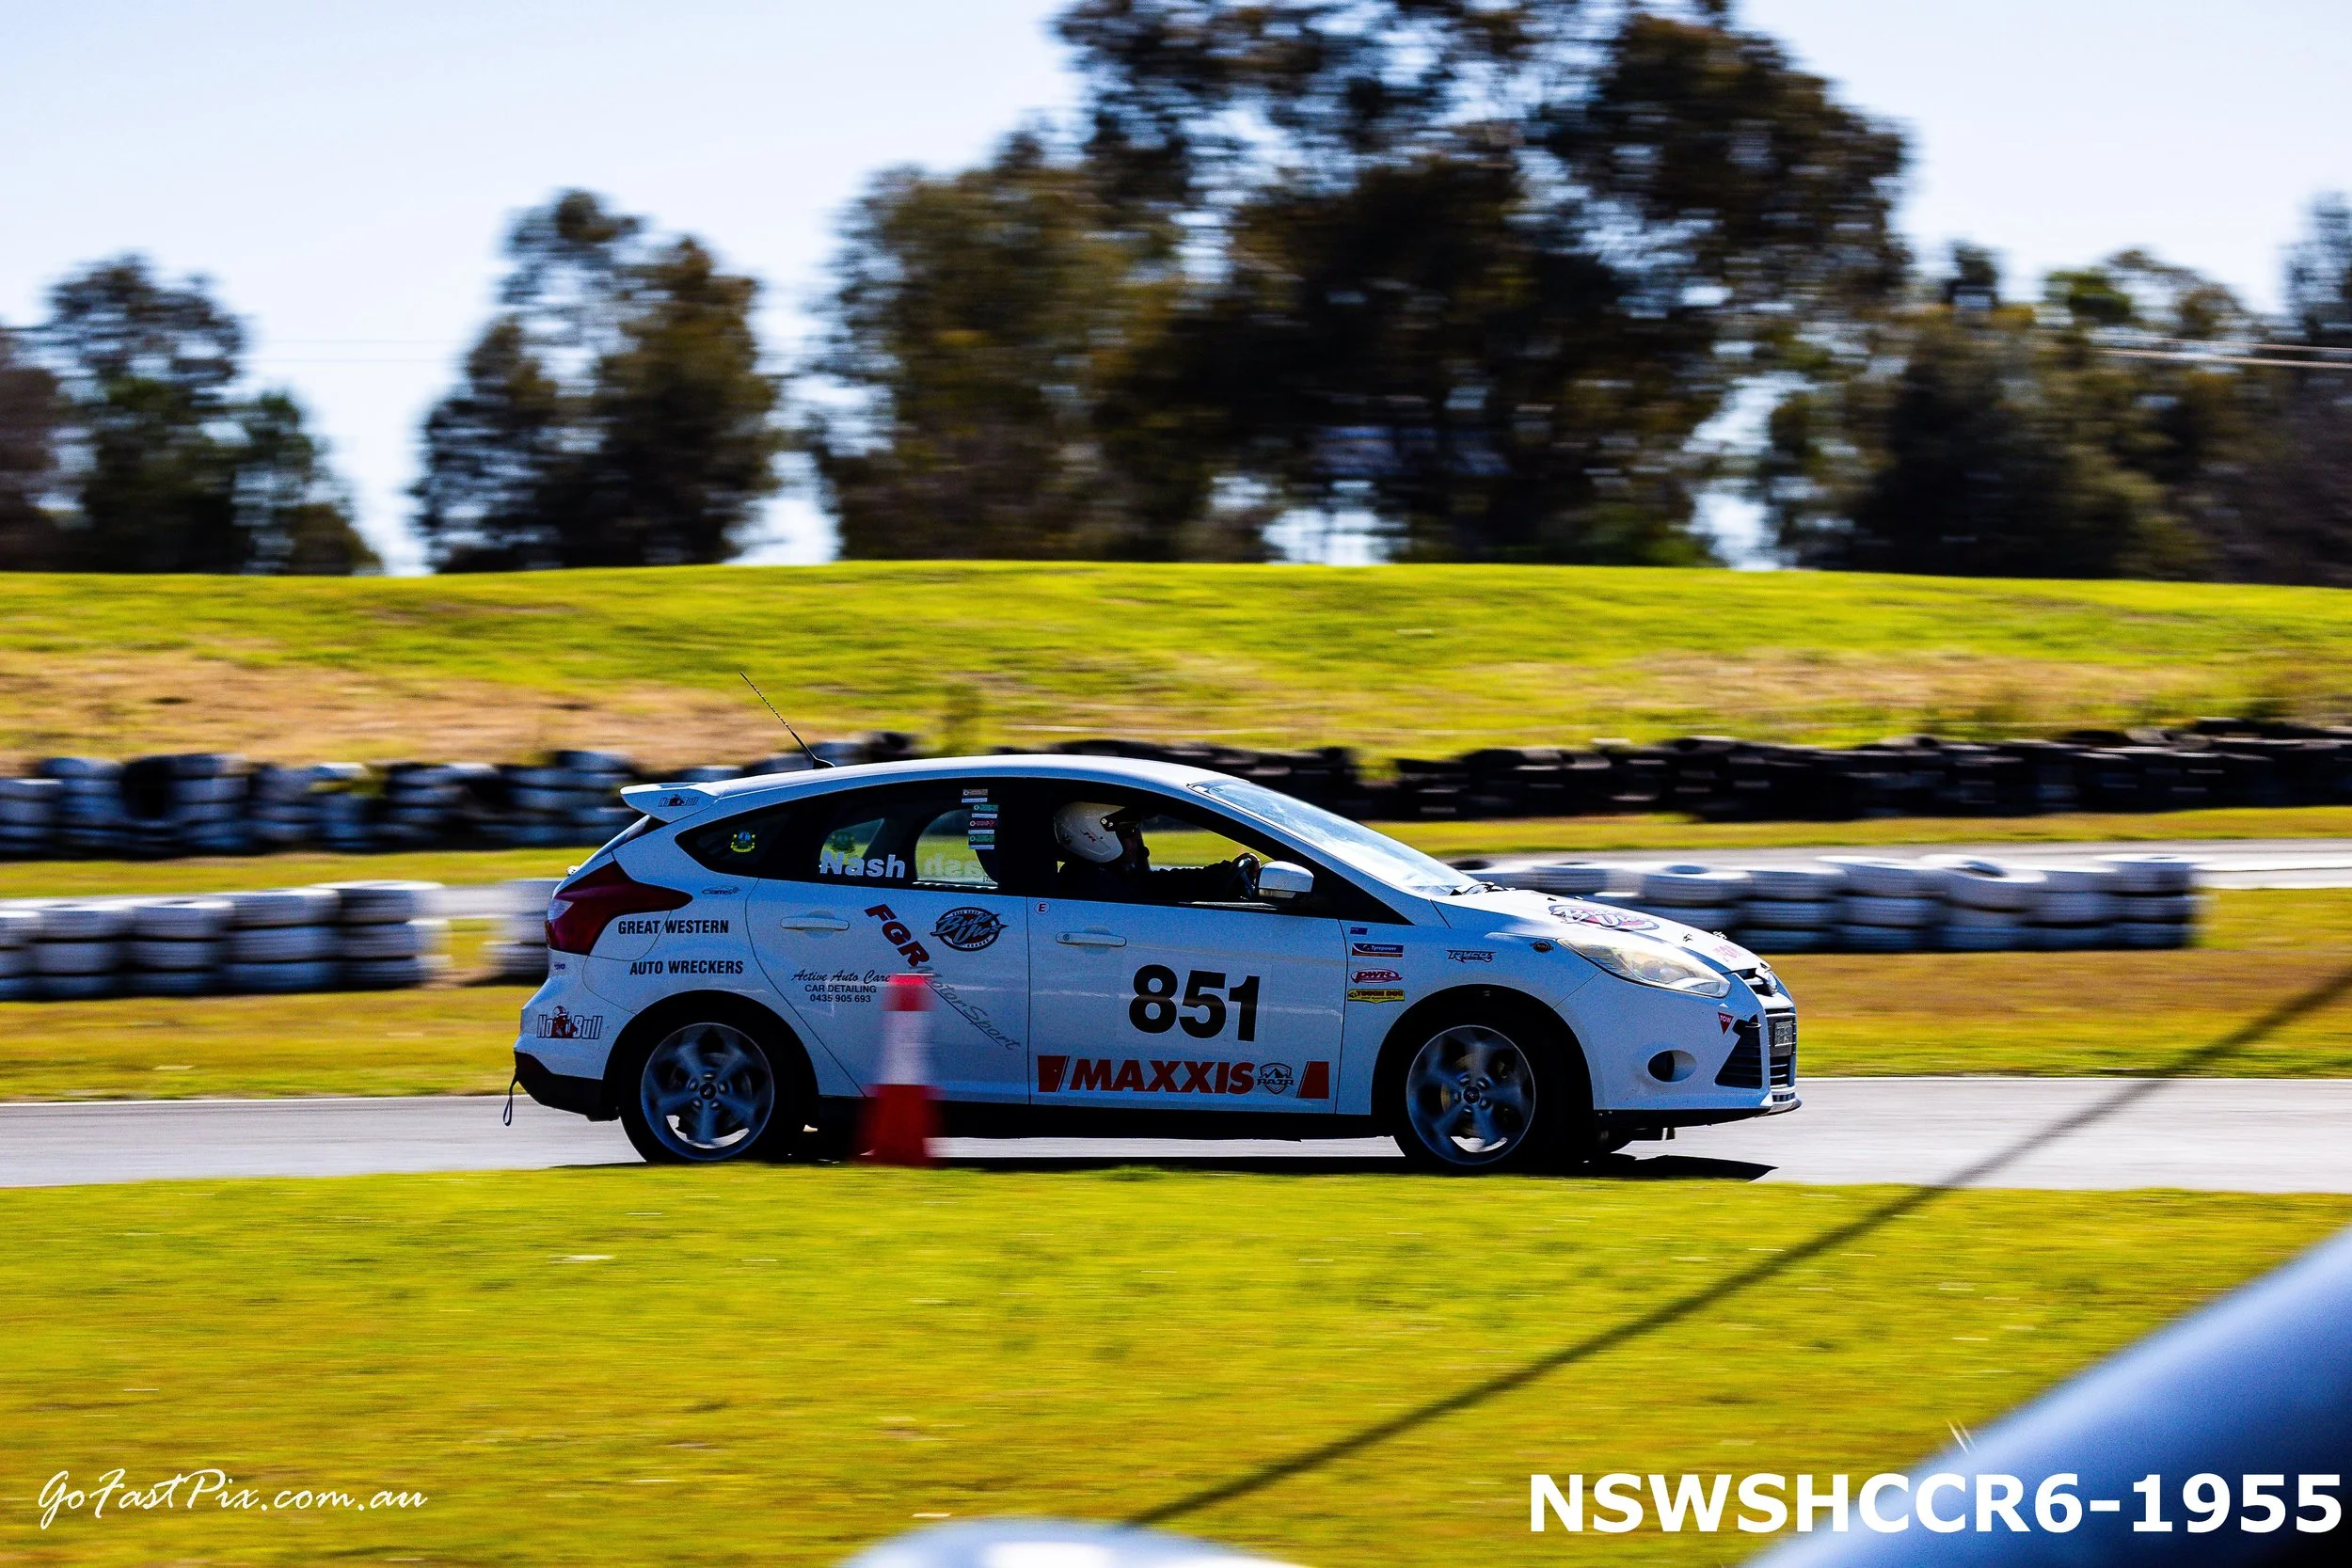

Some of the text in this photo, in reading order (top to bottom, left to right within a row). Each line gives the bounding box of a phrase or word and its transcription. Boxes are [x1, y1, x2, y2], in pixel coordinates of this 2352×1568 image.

[819, 850, 906, 878] Nash
[1038, 903, 1047, 913] E
[618, 919, 729, 935] GREAT WESTERN
[865, 904, 930, 967] FGR
[629, 960, 744, 975] AUTO WRECKERS
[790, 969, 891, 984] Active Auto Care
[804, 984, 877, 993] CAR DETAILING
[834, 994, 852, 1003] 905
[853, 994, 871, 1003] 693
[1129, 964, 1261, 1042] 851
[537, 1014, 603, 1039] No Bull
[1720, 1015, 1731, 1023] TOW
[1069, 1058, 1295, 1095] MAXXIS RAZR
